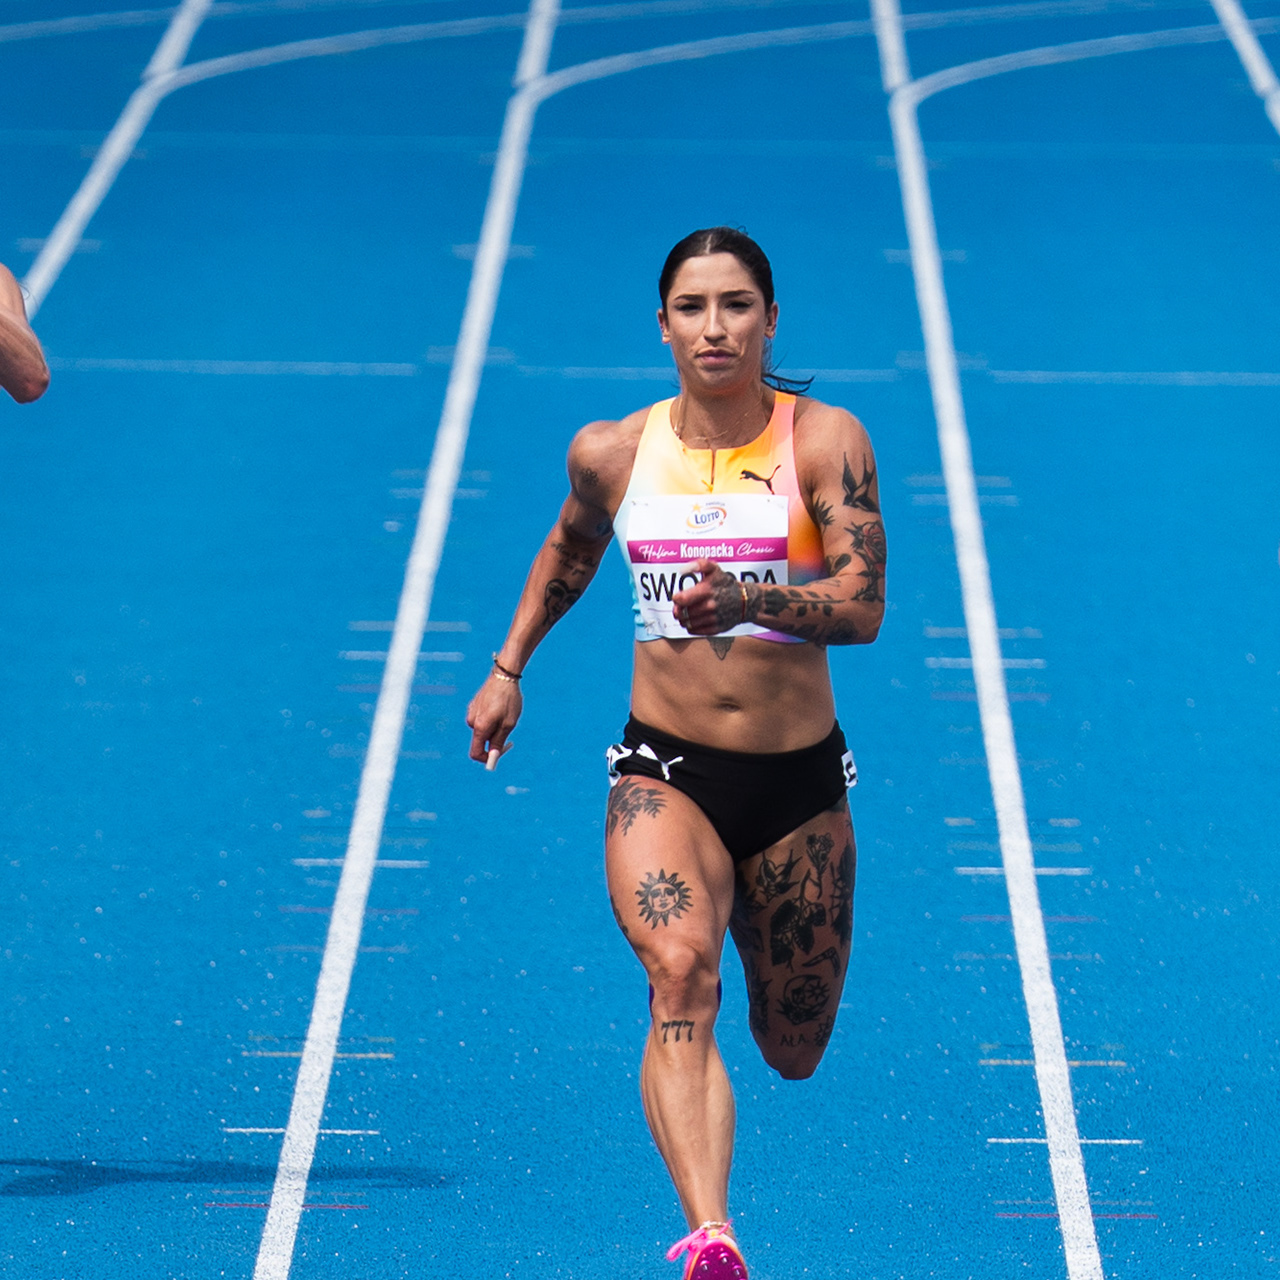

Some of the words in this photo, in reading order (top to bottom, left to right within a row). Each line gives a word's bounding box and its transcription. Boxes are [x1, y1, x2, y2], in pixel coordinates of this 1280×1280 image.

[694, 510, 720, 525] LOTTO
[638, 544, 678, 562] Halina
[680, 543, 734, 560] Konopacka
[736, 542, 776, 557] Classic
[640, 568, 778, 602] SWOA
[661, 1020, 695, 1044] 777
